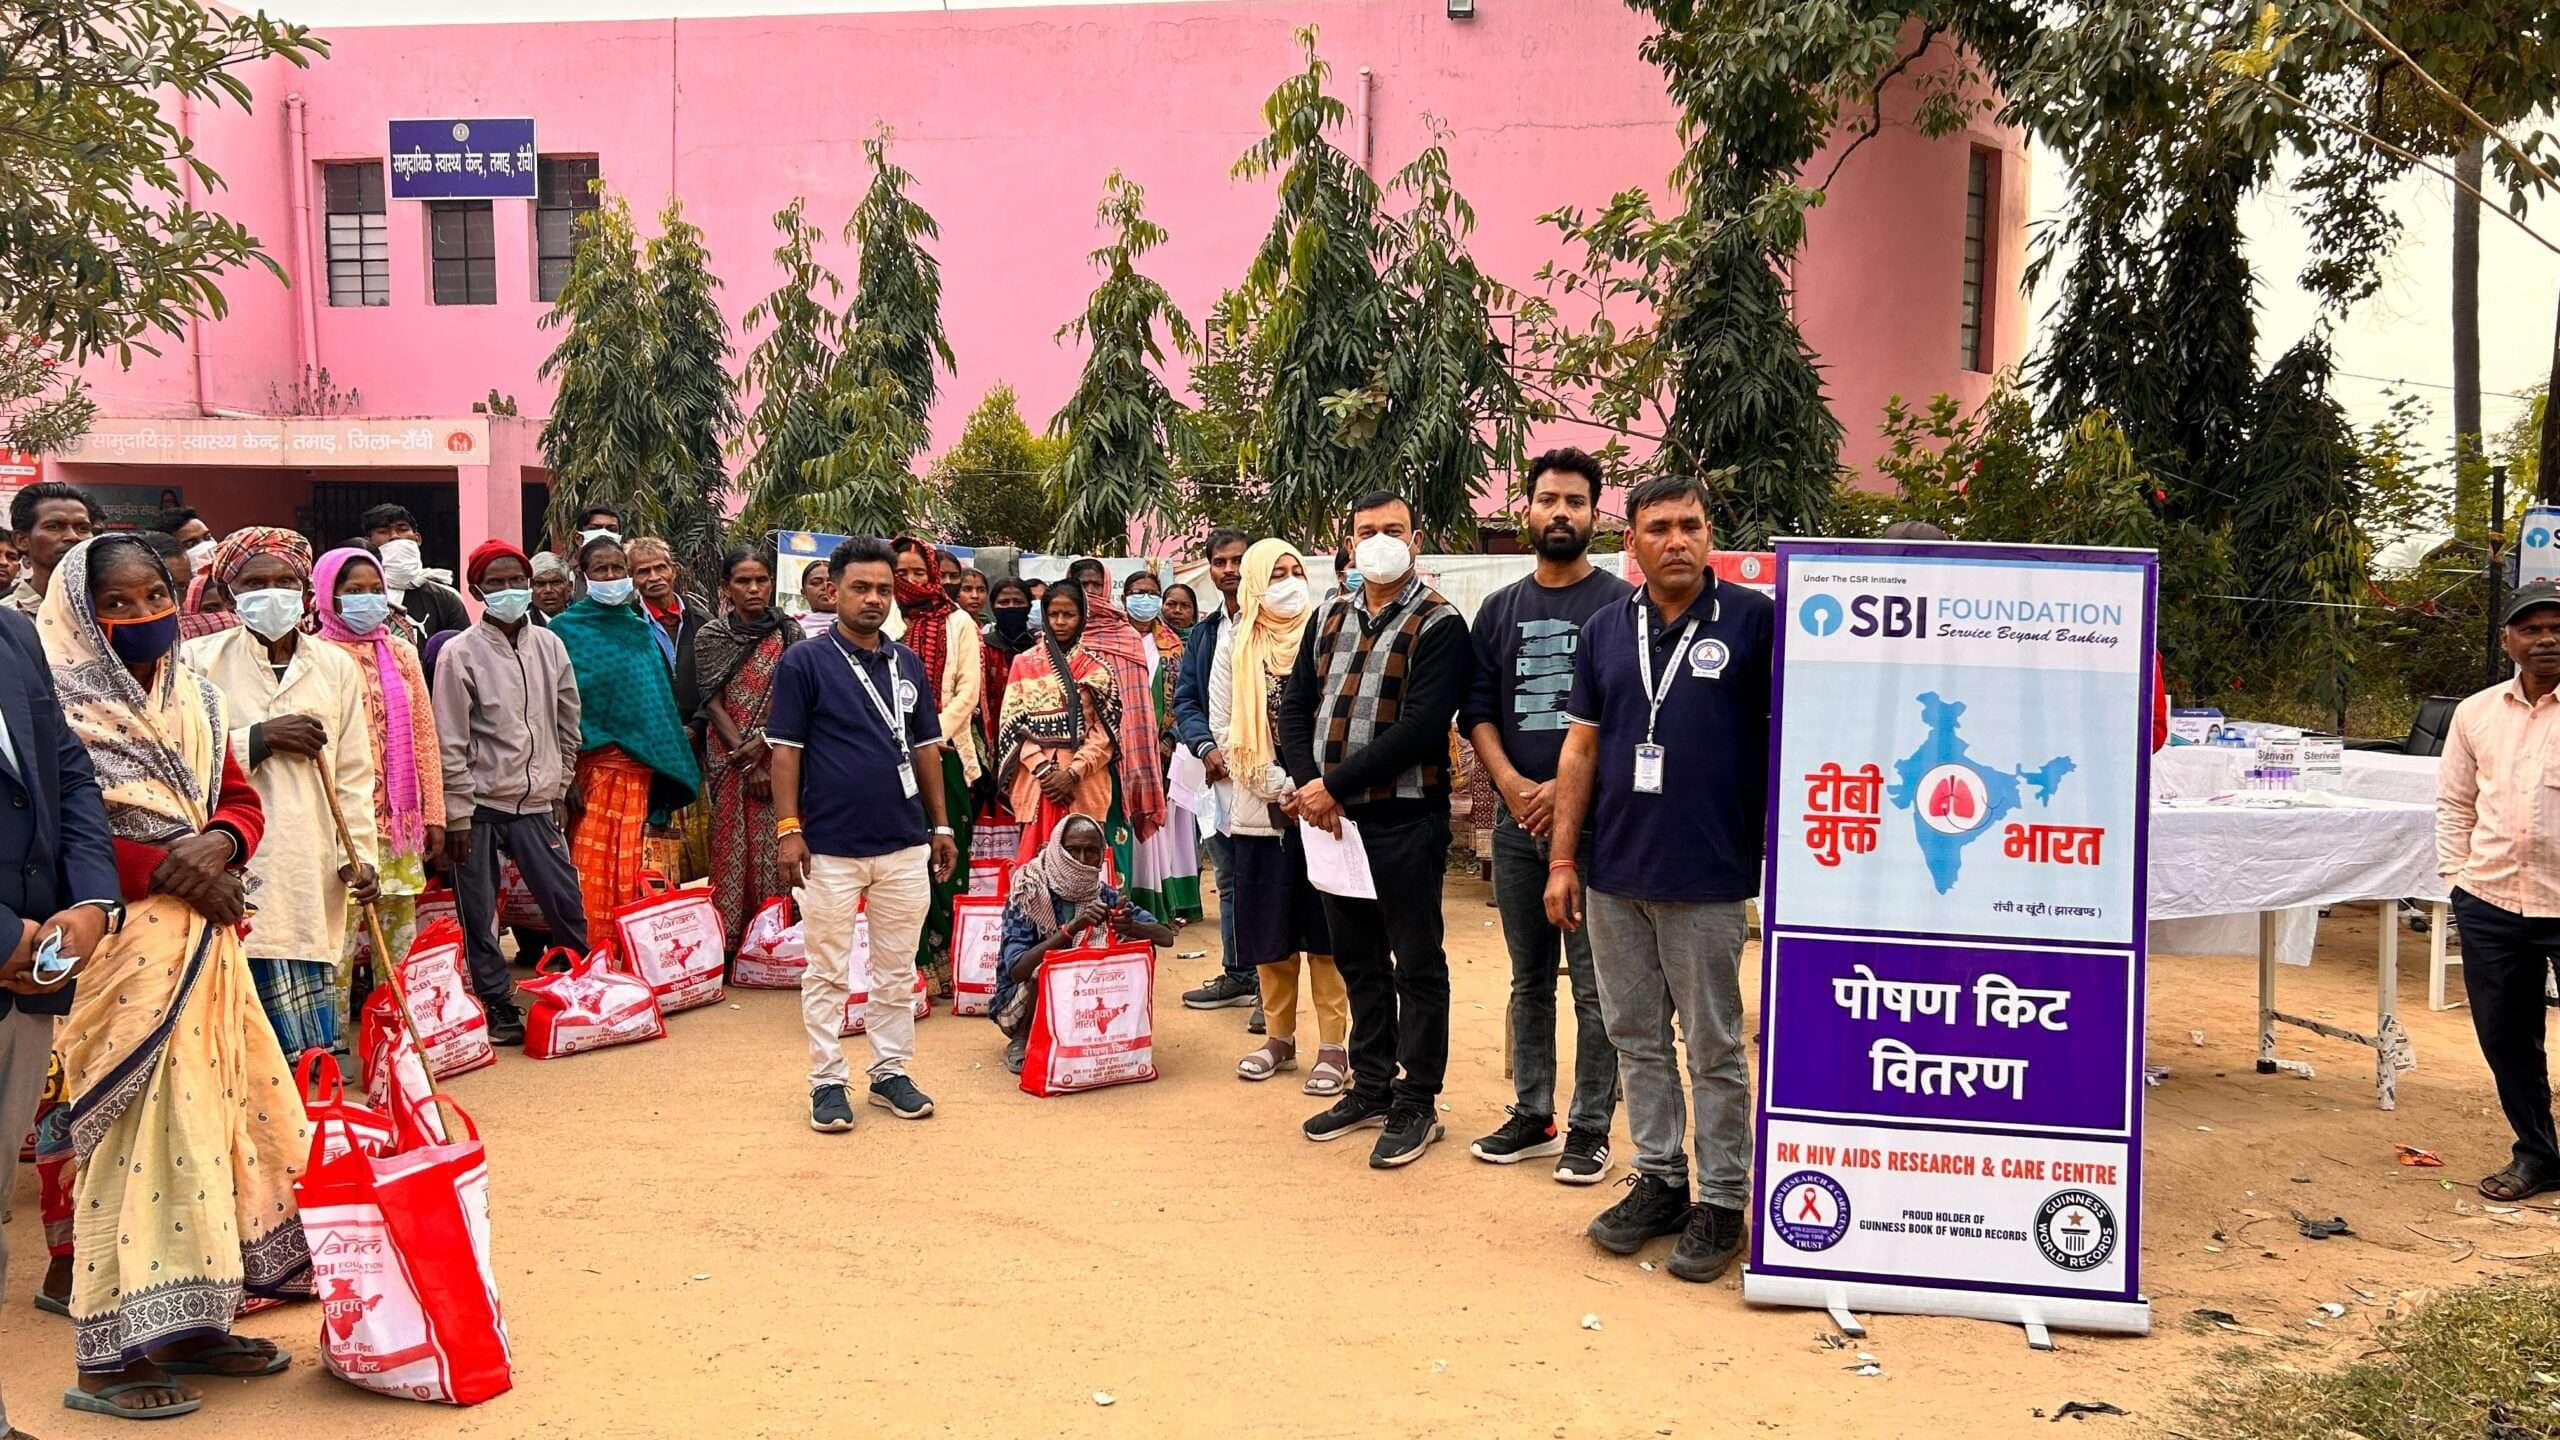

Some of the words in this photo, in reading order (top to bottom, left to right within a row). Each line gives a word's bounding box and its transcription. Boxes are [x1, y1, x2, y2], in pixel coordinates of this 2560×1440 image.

[393, 144, 432, 181] सामुदायिक
[435, 152, 461, 173] स्वास्थ्य
[92, 428, 175, 455] सामुदायिक
[183, 434, 236, 450] स्वास्थ्य
[1804, 574, 1830, 583] Under
[1832, 575, 1848, 583] The
[1850, 575, 1869, 583] CSR
[1871, 576, 1907, 585] Initiative
[1850, 594, 1928, 639] SBI
[1937, 597, 2122, 625] FOUNDATION
[1937, 623, 1992, 639] Service
[1997, 626, 2052, 642] Beyond
[2055, 628, 2120, 648] Banking
[1804, 762, 1885, 815] टीबी
[1803, 814, 1881, 868] मुक्त
[2003, 824, 2105, 866] भारत
[1992, 900, 2014, 913] रांची
[2016, 904, 2023, 912] व
[1832, 964, 1961, 1025] पोषण
[1972, 973, 2071, 1031] किट
[1868, 1038, 2029, 1100] वितरण
[1777, 1142, 1800, 1164] RK
[1806, 1145, 1836, 1167] HIV
[1841, 1148, 1882, 1169] AIDS
[1888, 1151, 1975, 1176] RESEARCH
[1981, 1156, 1995, 1177] &
[2001, 1158, 2045, 1181] CARE
[2051, 1161, 2117, 1186] CENTRE
[1780, 1175, 1828, 1193] RESEARCH
[1902, 1209, 1933, 1221] PROUD
[1936, 1211, 1971, 1224] HOLDER
[1973, 1214, 1985, 1225] OF
[2045, 1194, 2107, 1218] GUINNESS
[1859, 1219, 1906, 1233] GUINNESS
[1908, 1223, 1933, 1235] BOOK
[1936, 1225, 1947, 1236] OF
[1949, 1226, 1982, 1239] WORLD
[1984, 1229, 2028, 1242] RECORDS
[1796, 1240, 1824, 1250] TRUST
[2038, 1223, 2065, 1262] WORLD
[2069, 1227, 2113, 1267] RECORDS
